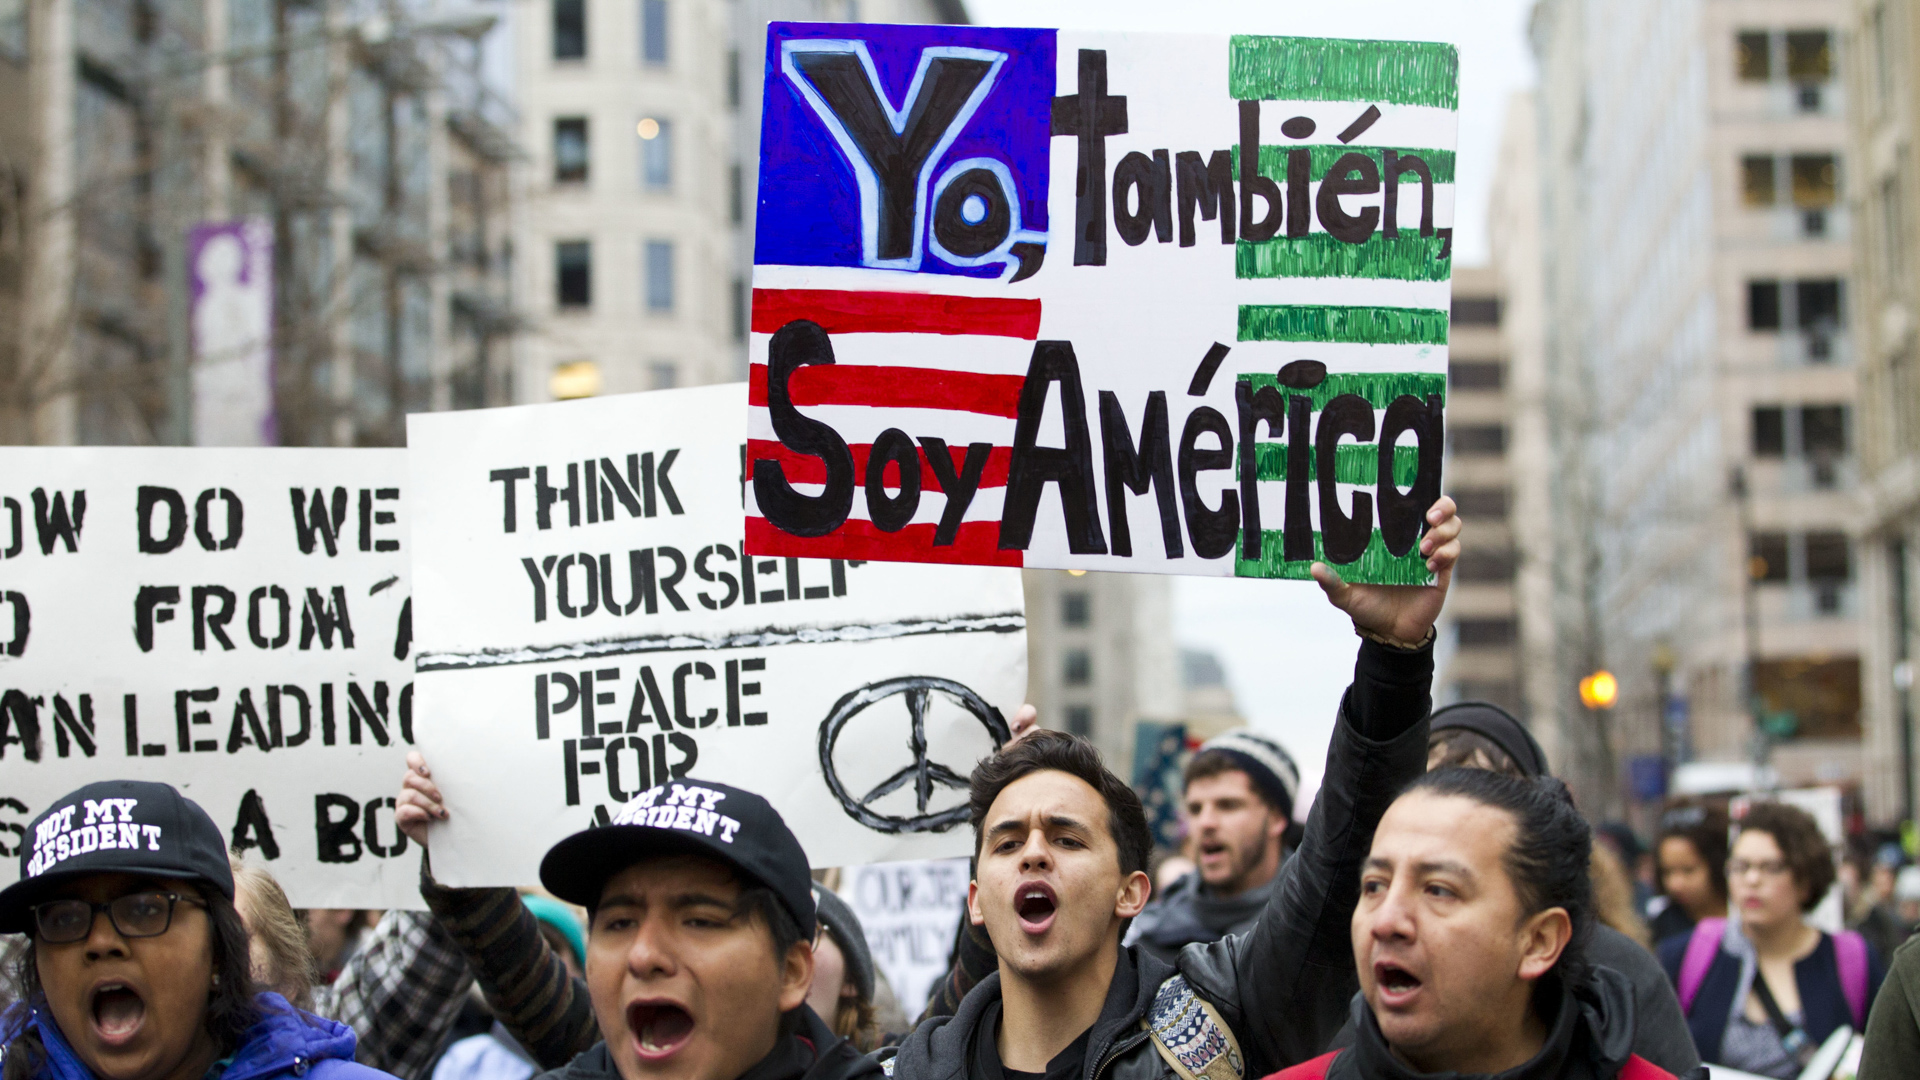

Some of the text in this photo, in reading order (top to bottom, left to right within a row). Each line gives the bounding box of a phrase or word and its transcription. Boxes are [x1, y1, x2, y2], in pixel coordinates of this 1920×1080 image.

[781, 38, 1453, 283] Yo, también,
[752, 318, 1443, 565] Soy América
[136, 484, 243, 555] DO
[289, 486, 401, 557] WE
[489, 448, 685, 534] THINK
[132, 583, 356, 653] FROM
[535, 657, 769, 740] PEACE
[563, 731, 698, 807] FOR
[665, 784, 726, 811] MY
[27, 822, 161, 878] PRESIDENT
[34, 798, 138, 852] NOT MY
[230, 788, 281, 861] A
